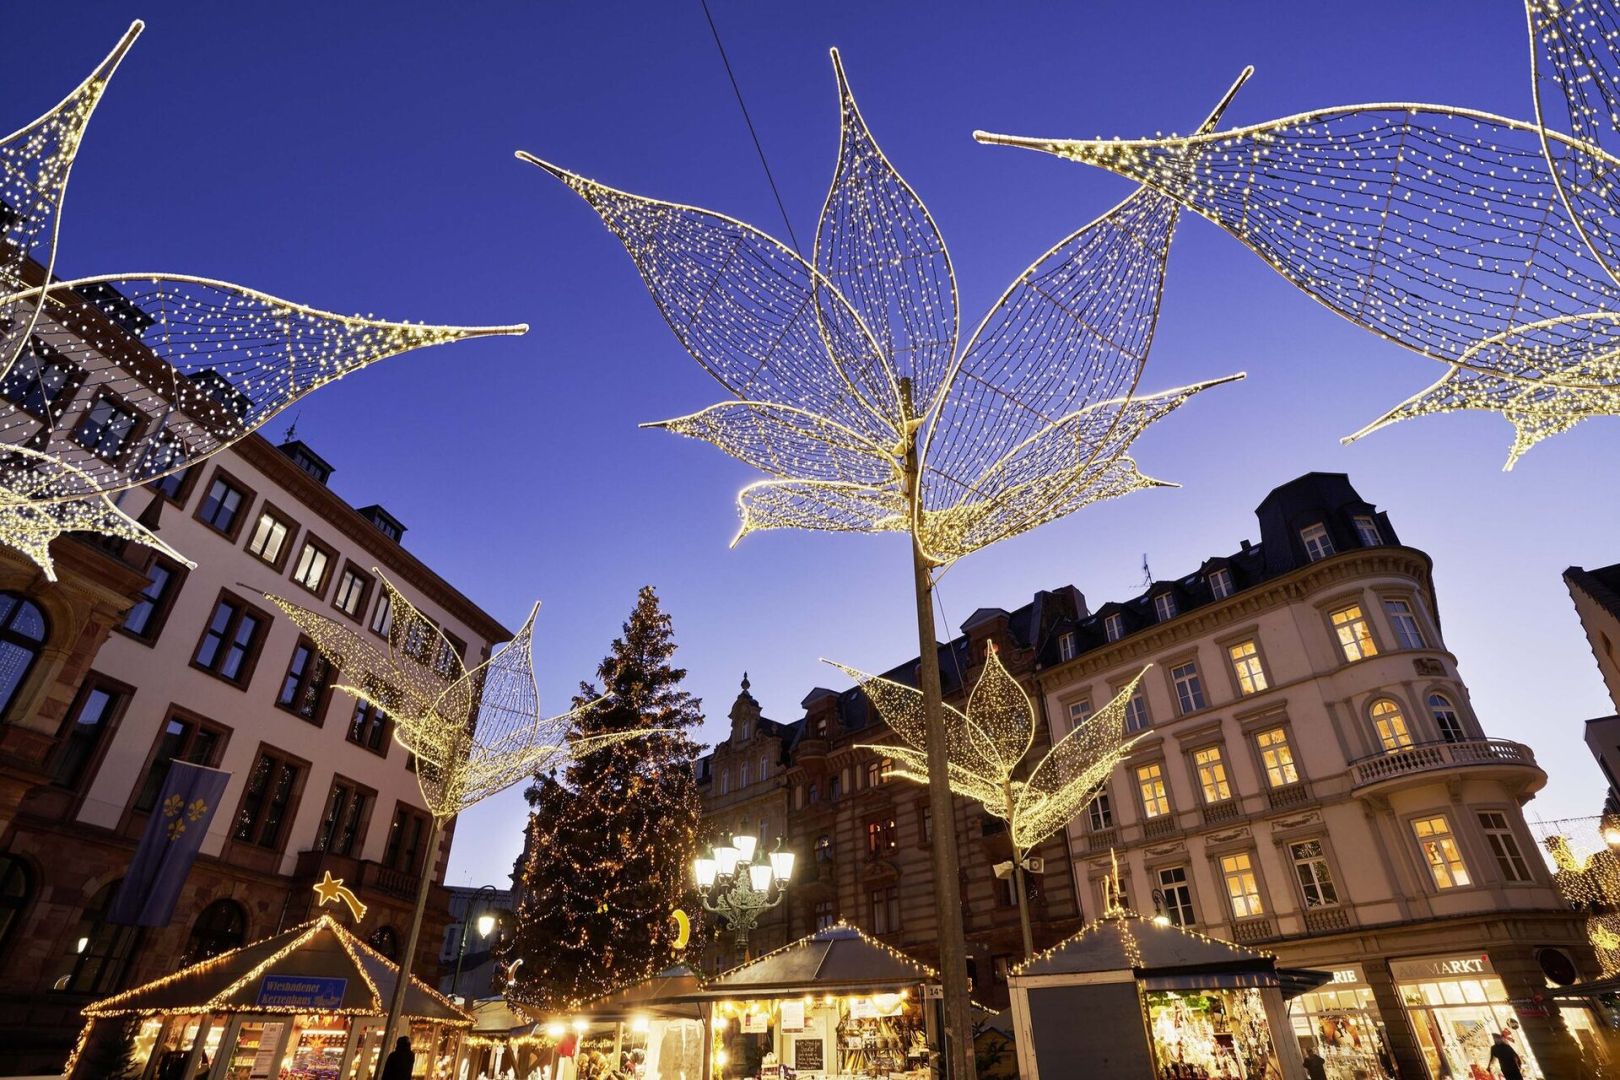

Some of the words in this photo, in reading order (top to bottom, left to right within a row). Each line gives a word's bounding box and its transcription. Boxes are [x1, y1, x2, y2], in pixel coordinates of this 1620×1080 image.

[1425, 959, 1484, 976] MARKT
[1327, 970, 1358, 985] RIE
[266, 981, 321, 993] Wiesbadener
